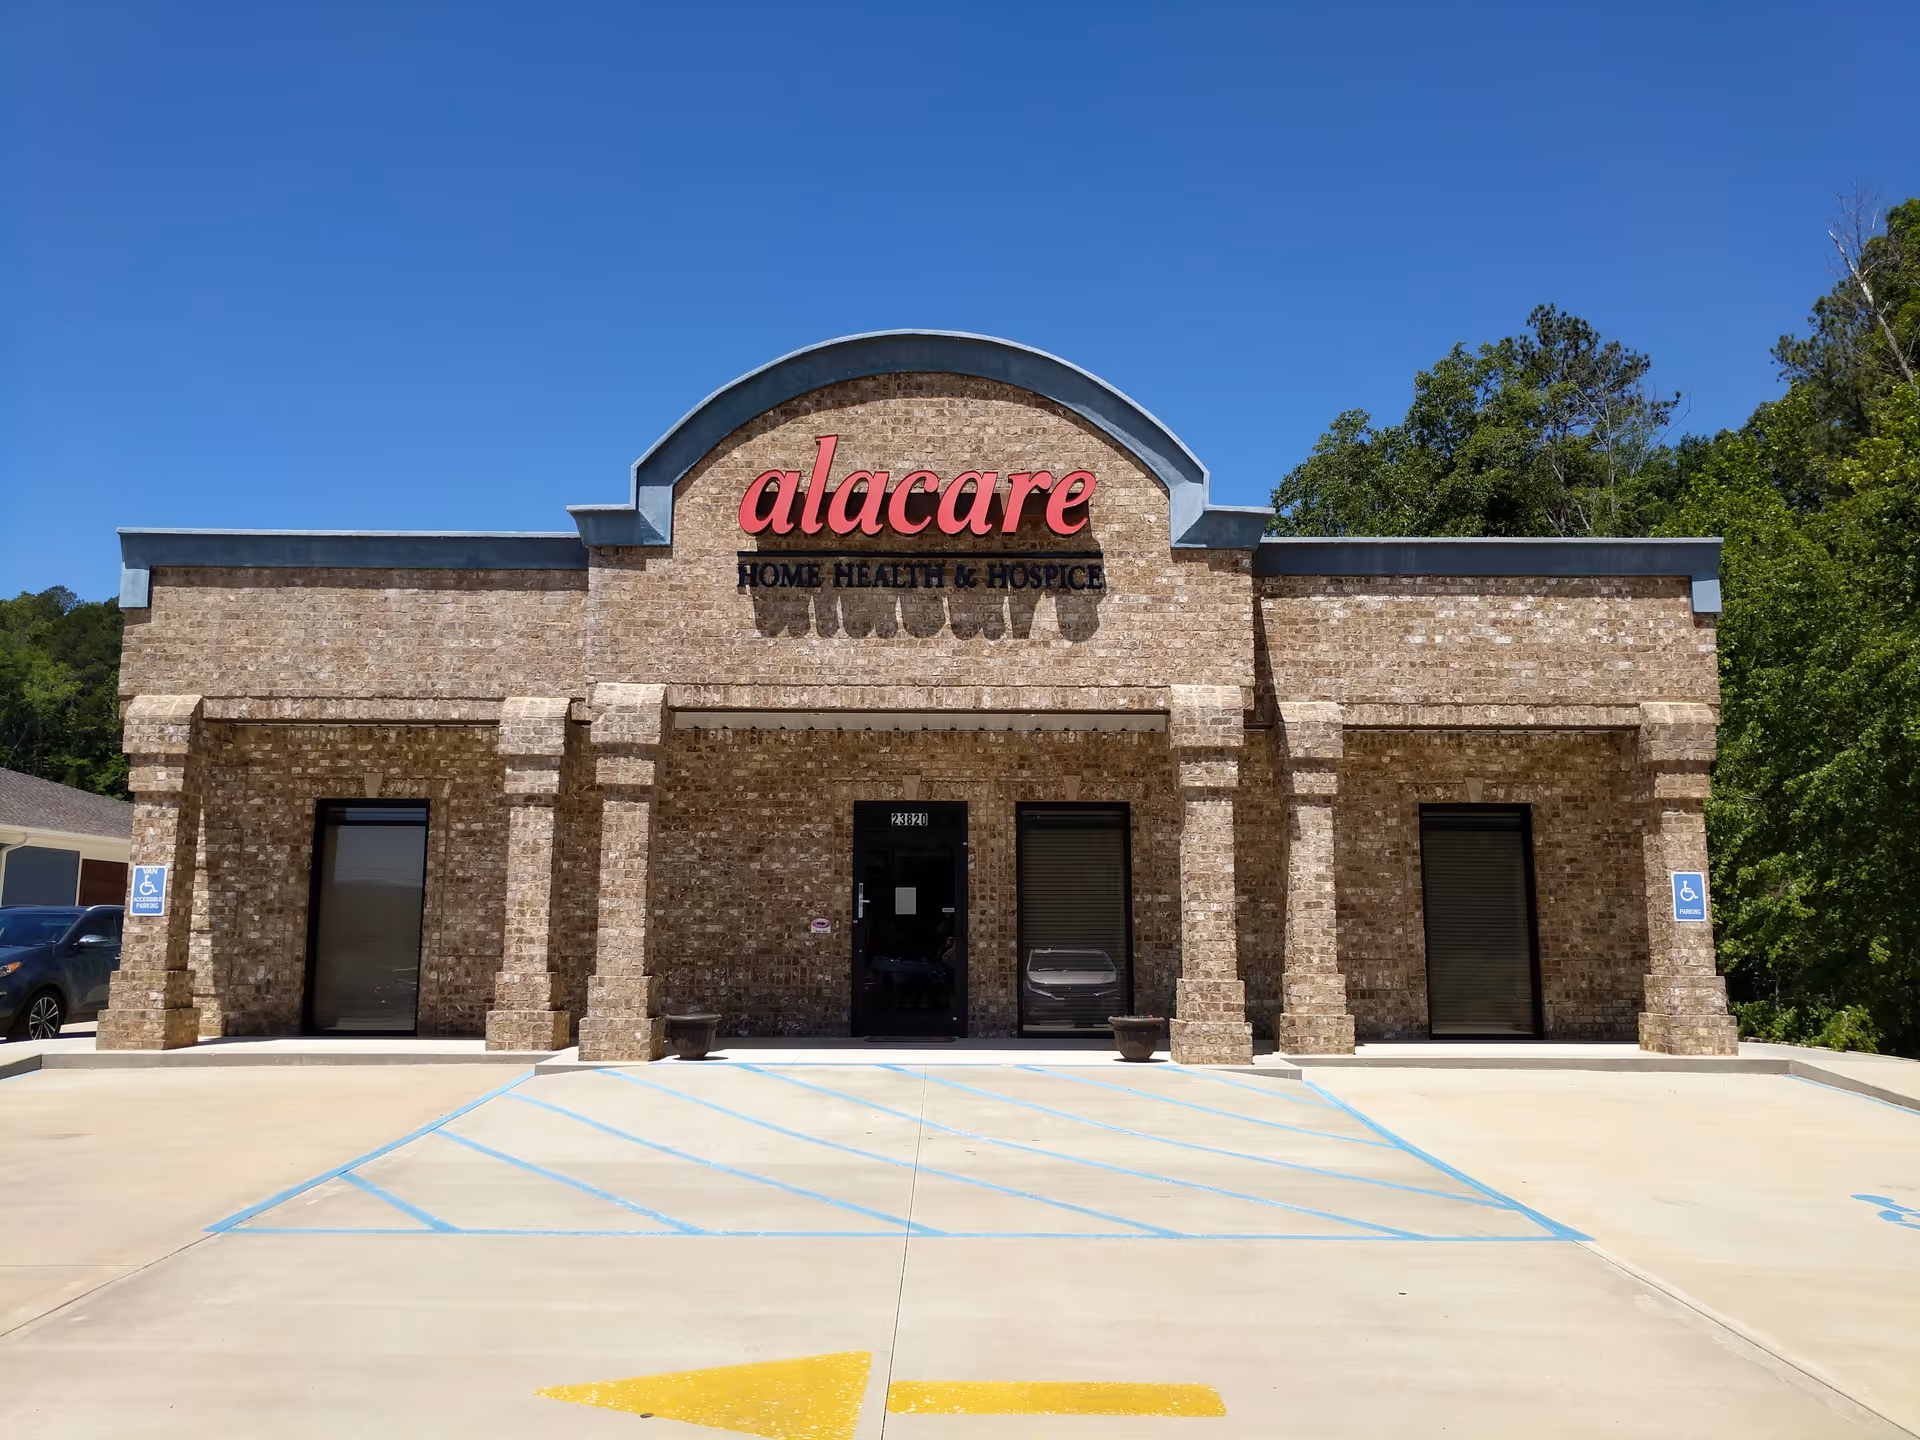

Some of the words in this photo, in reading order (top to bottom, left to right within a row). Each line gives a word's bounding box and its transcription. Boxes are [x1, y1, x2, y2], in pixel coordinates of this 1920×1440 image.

[738, 434, 1098, 536] alacare
[736, 561, 821, 588] HOME
[832, 562, 944, 588] HEALTH
[953, 563, 977, 589] &
[986, 563, 1105, 590] HOSPICE
[892, 813, 927, 825] 23820
[143, 867, 158, 875] VAN
